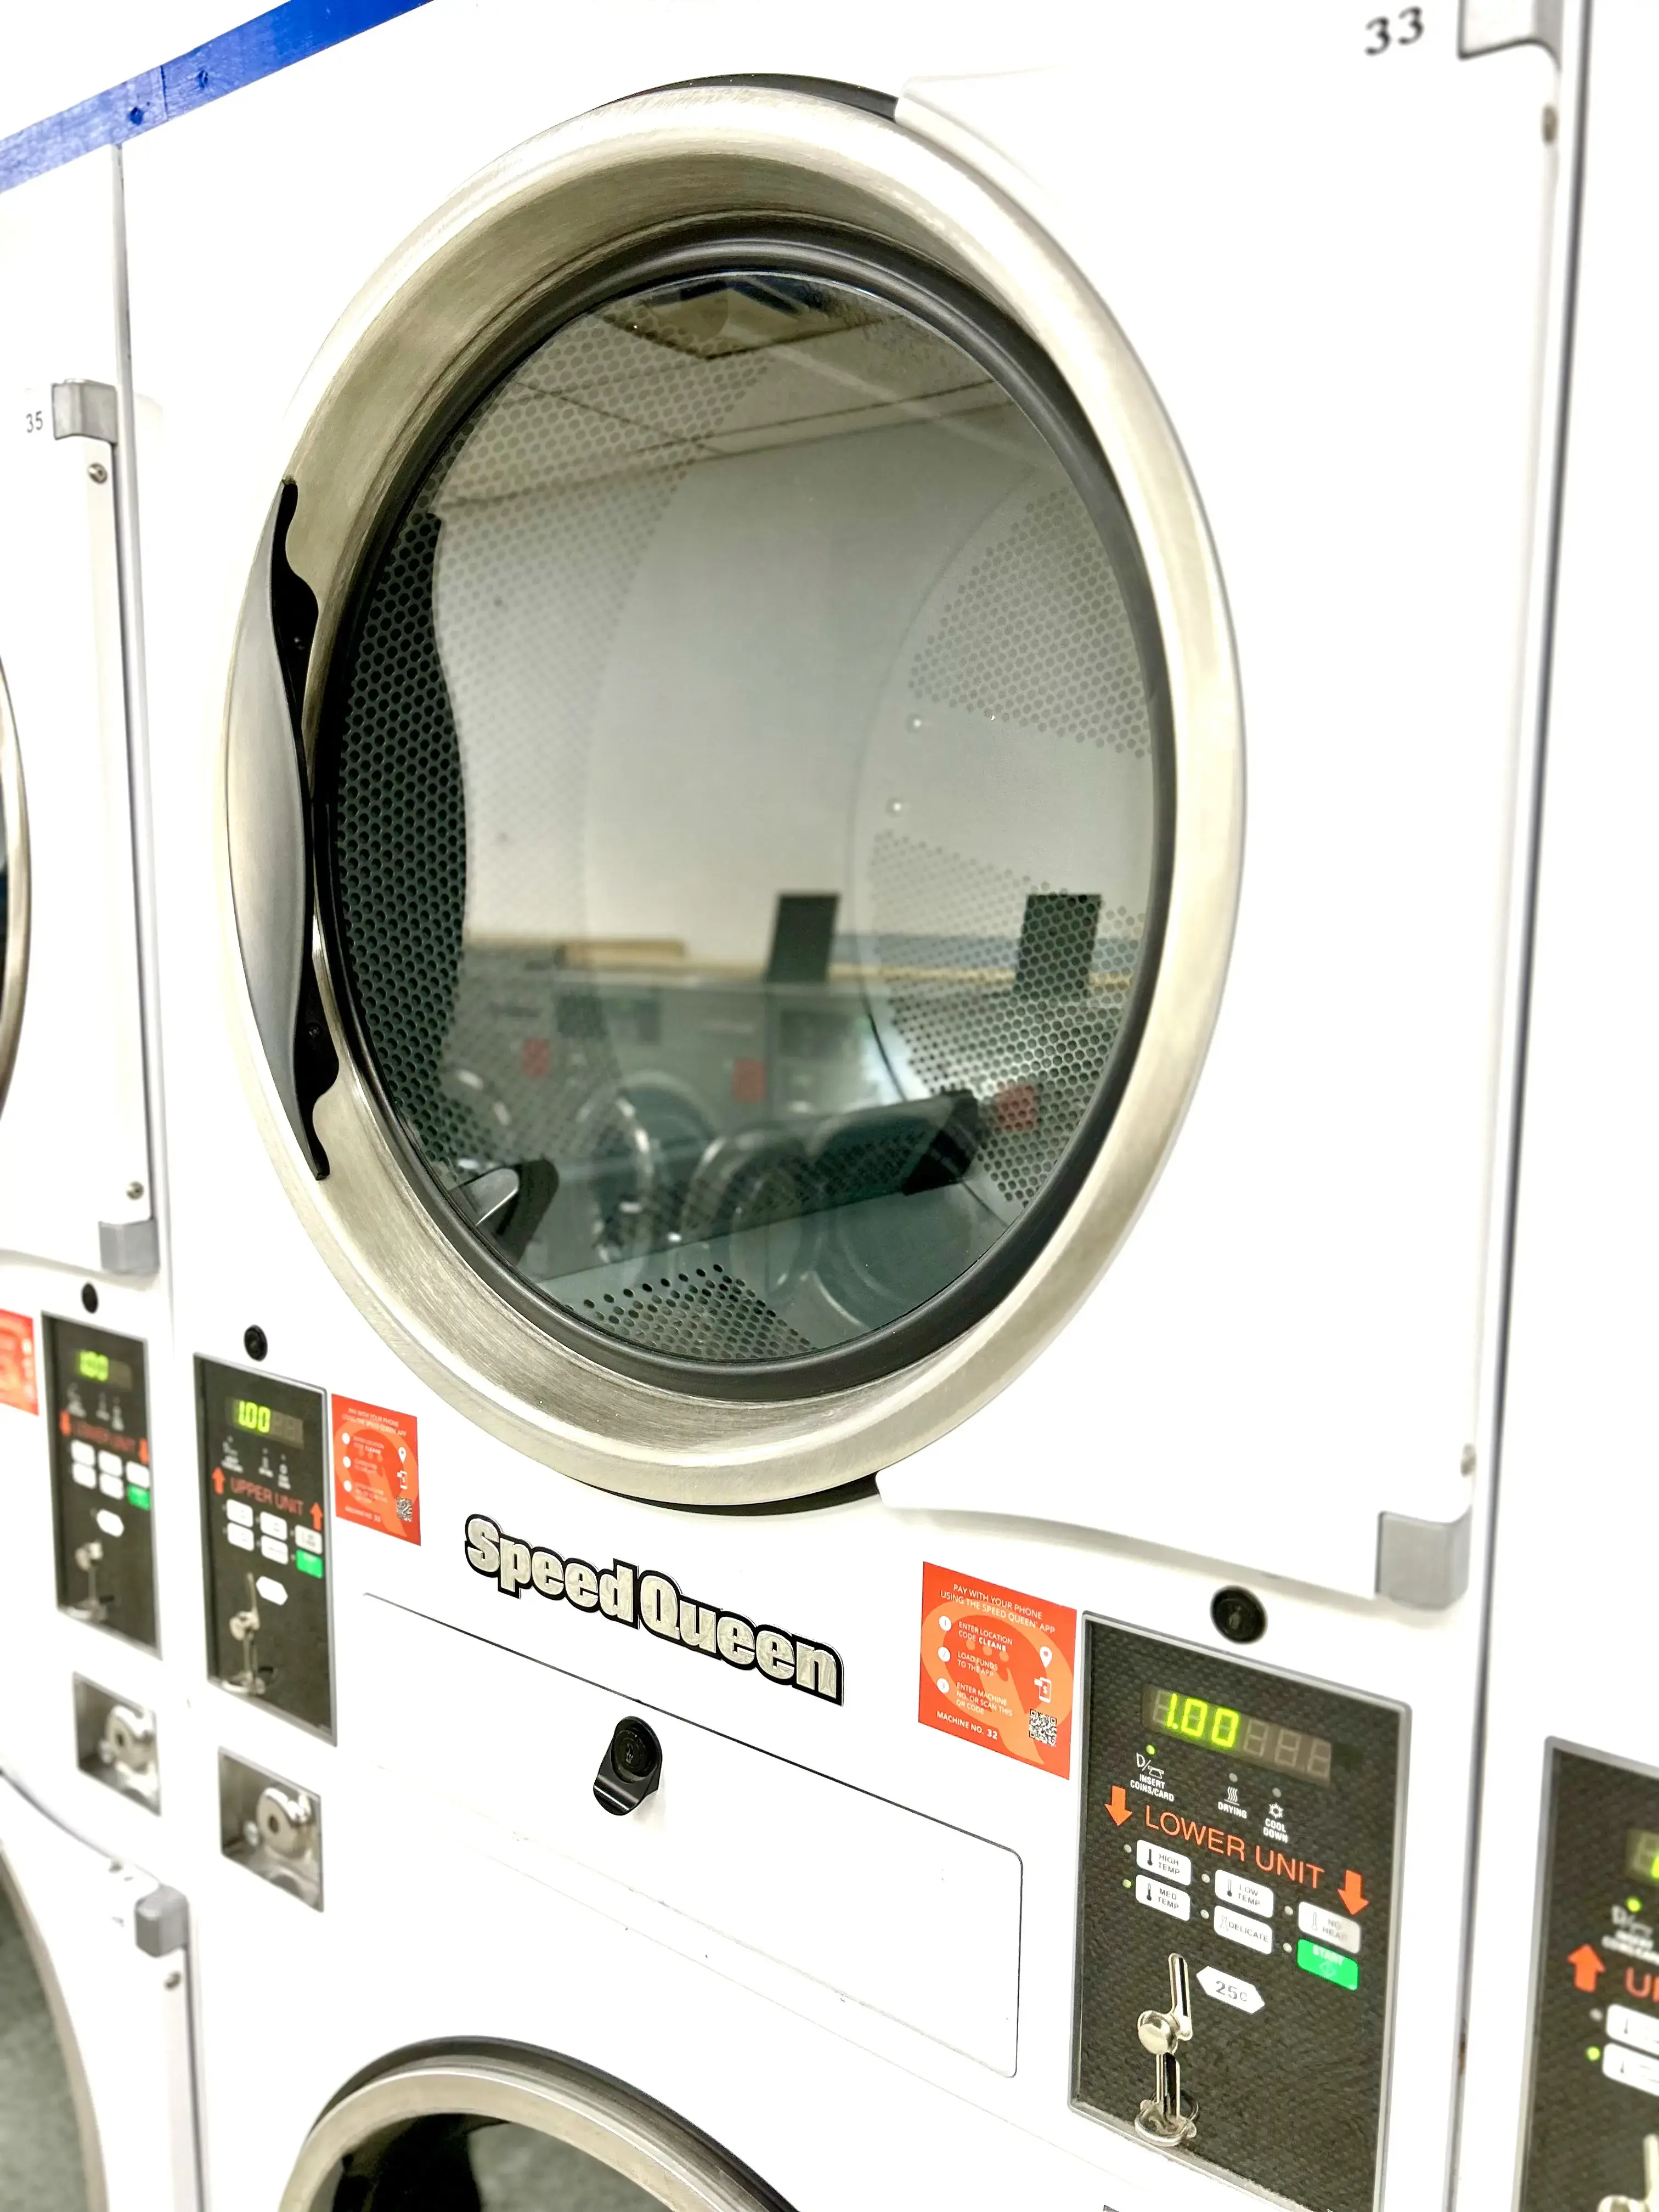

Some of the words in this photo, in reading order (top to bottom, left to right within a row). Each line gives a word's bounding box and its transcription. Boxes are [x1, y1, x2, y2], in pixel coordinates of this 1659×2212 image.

[1364, 6, 1425, 56] 33
[26, 411, 43, 433] 35
[230, 1477, 273, 1505] UPPER
[274, 1492, 304, 1516] UNIT
[465, 1514, 640, 1629] Speed
[639, 1570, 844, 1706] Queen
[940, 1589, 964, 1605] USING
[966, 1599, 981, 1610] THE
[981, 1605, 1007, 1618] SPEED
[1039, 1623, 1056, 1634] APP
[953, 1583, 968, 1595] PAY
[968, 1589, 989, 1602] WITH
[990, 1596, 1013, 1610] YOUR
[1014, 1603, 1042, 1620] PHONE
[958, 1621, 979, 1633] ENTER
[979, 1628, 1013, 1646] LOCATION
[958, 1630, 977, 1642] CODE
[957, 1651, 977, 1663] LOAD
[975, 1657, 998, 1671] FUNDS
[957, 1659, 967, 1668] TO
[967, 1663, 981, 1674] THE
[956, 1681, 977, 1695] ENTER
[978, 1689, 1008, 1706] MACHINE
[966, 1703, 985, 1715] CODE
[969, 1695, 979, 1705] OR
[980, 1699, 997, 1711] SCAN
[998, 1706, 1013, 1717] THIS
[936, 1711, 970, 1729] MACHINE
[970, 1724, 984, 1735] NO.
[986, 1728, 998, 1740] 32
[1166, 1693, 1240, 1748] 1.00
[1130, 1779, 1175, 1802] COINS/CARD
[1139, 1774, 1165, 1790] INSERT
[1217, 1801, 1248, 1819] DRYING
[1263, 1826, 1289, 1843] DOWN
[1265, 1818, 1286, 1833] COOL
[1145, 1805, 1245, 1861] LOWER
[1255, 1845, 1325, 1889] UNIT
[1158, 1862, 1180, 1875] TEMP
[1159, 1853, 1180, 1866] HIGH
[1159, 1888, 1177, 1900] MED
[1238, 1892, 1261, 1906] TEMP
[1239, 1883, 1259, 1897] LOW
[1158, 1896, 1180, 1910] TEMP
[1228, 1921, 1268, 1943] DELICATE
